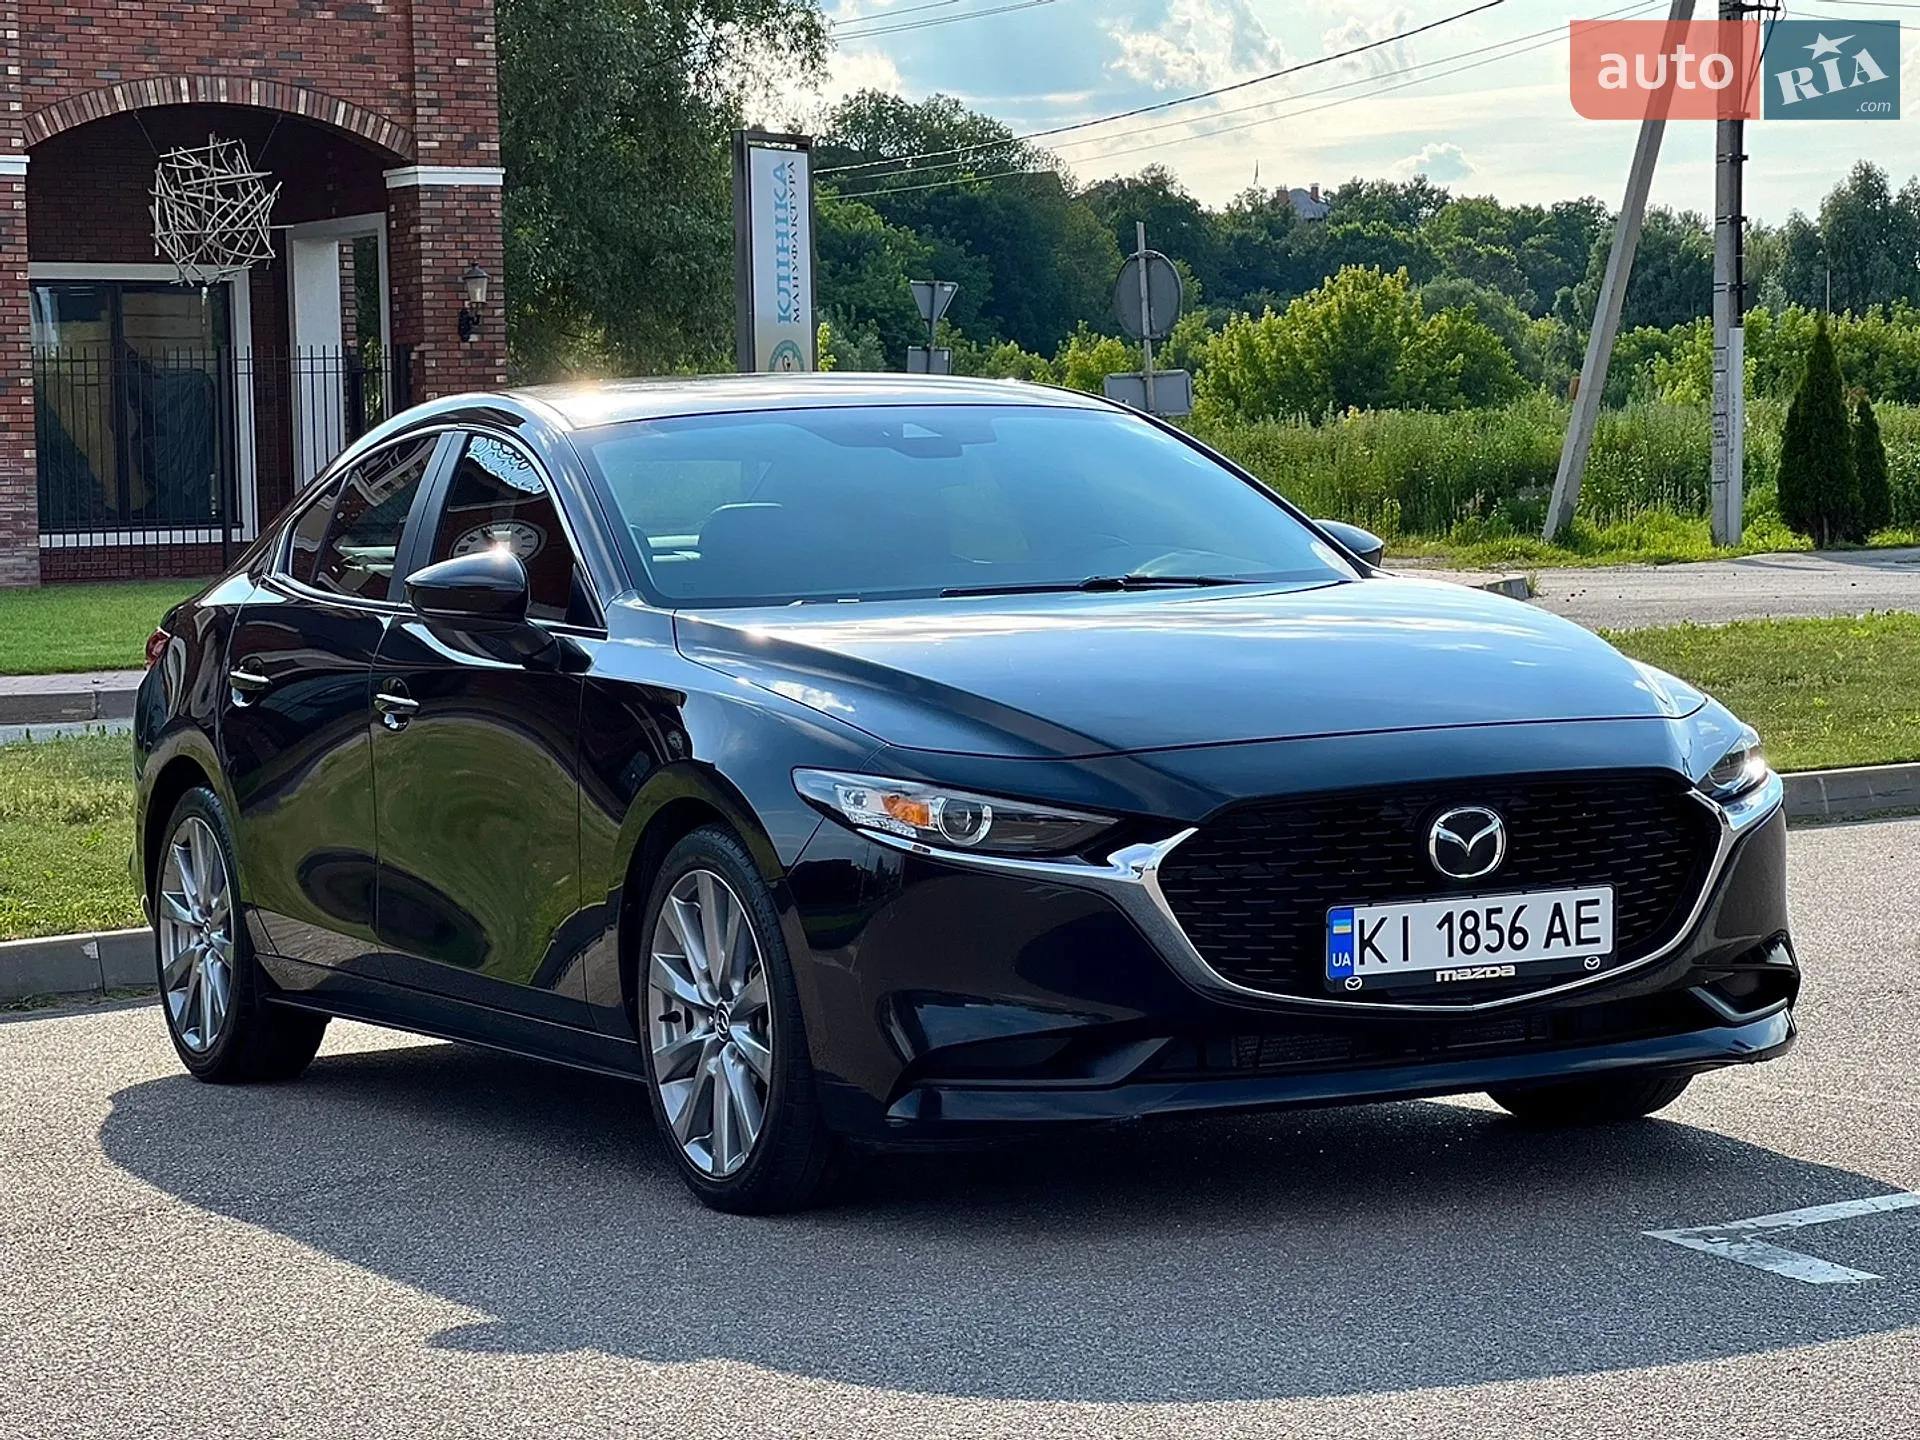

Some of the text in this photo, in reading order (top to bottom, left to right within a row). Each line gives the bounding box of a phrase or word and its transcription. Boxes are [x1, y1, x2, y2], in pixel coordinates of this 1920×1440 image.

[773, 161, 792, 324] КЛІНІКА
[1332, 952, 1352, 968] UA
[1358, 899, 1602, 965] KI 1856 AE
